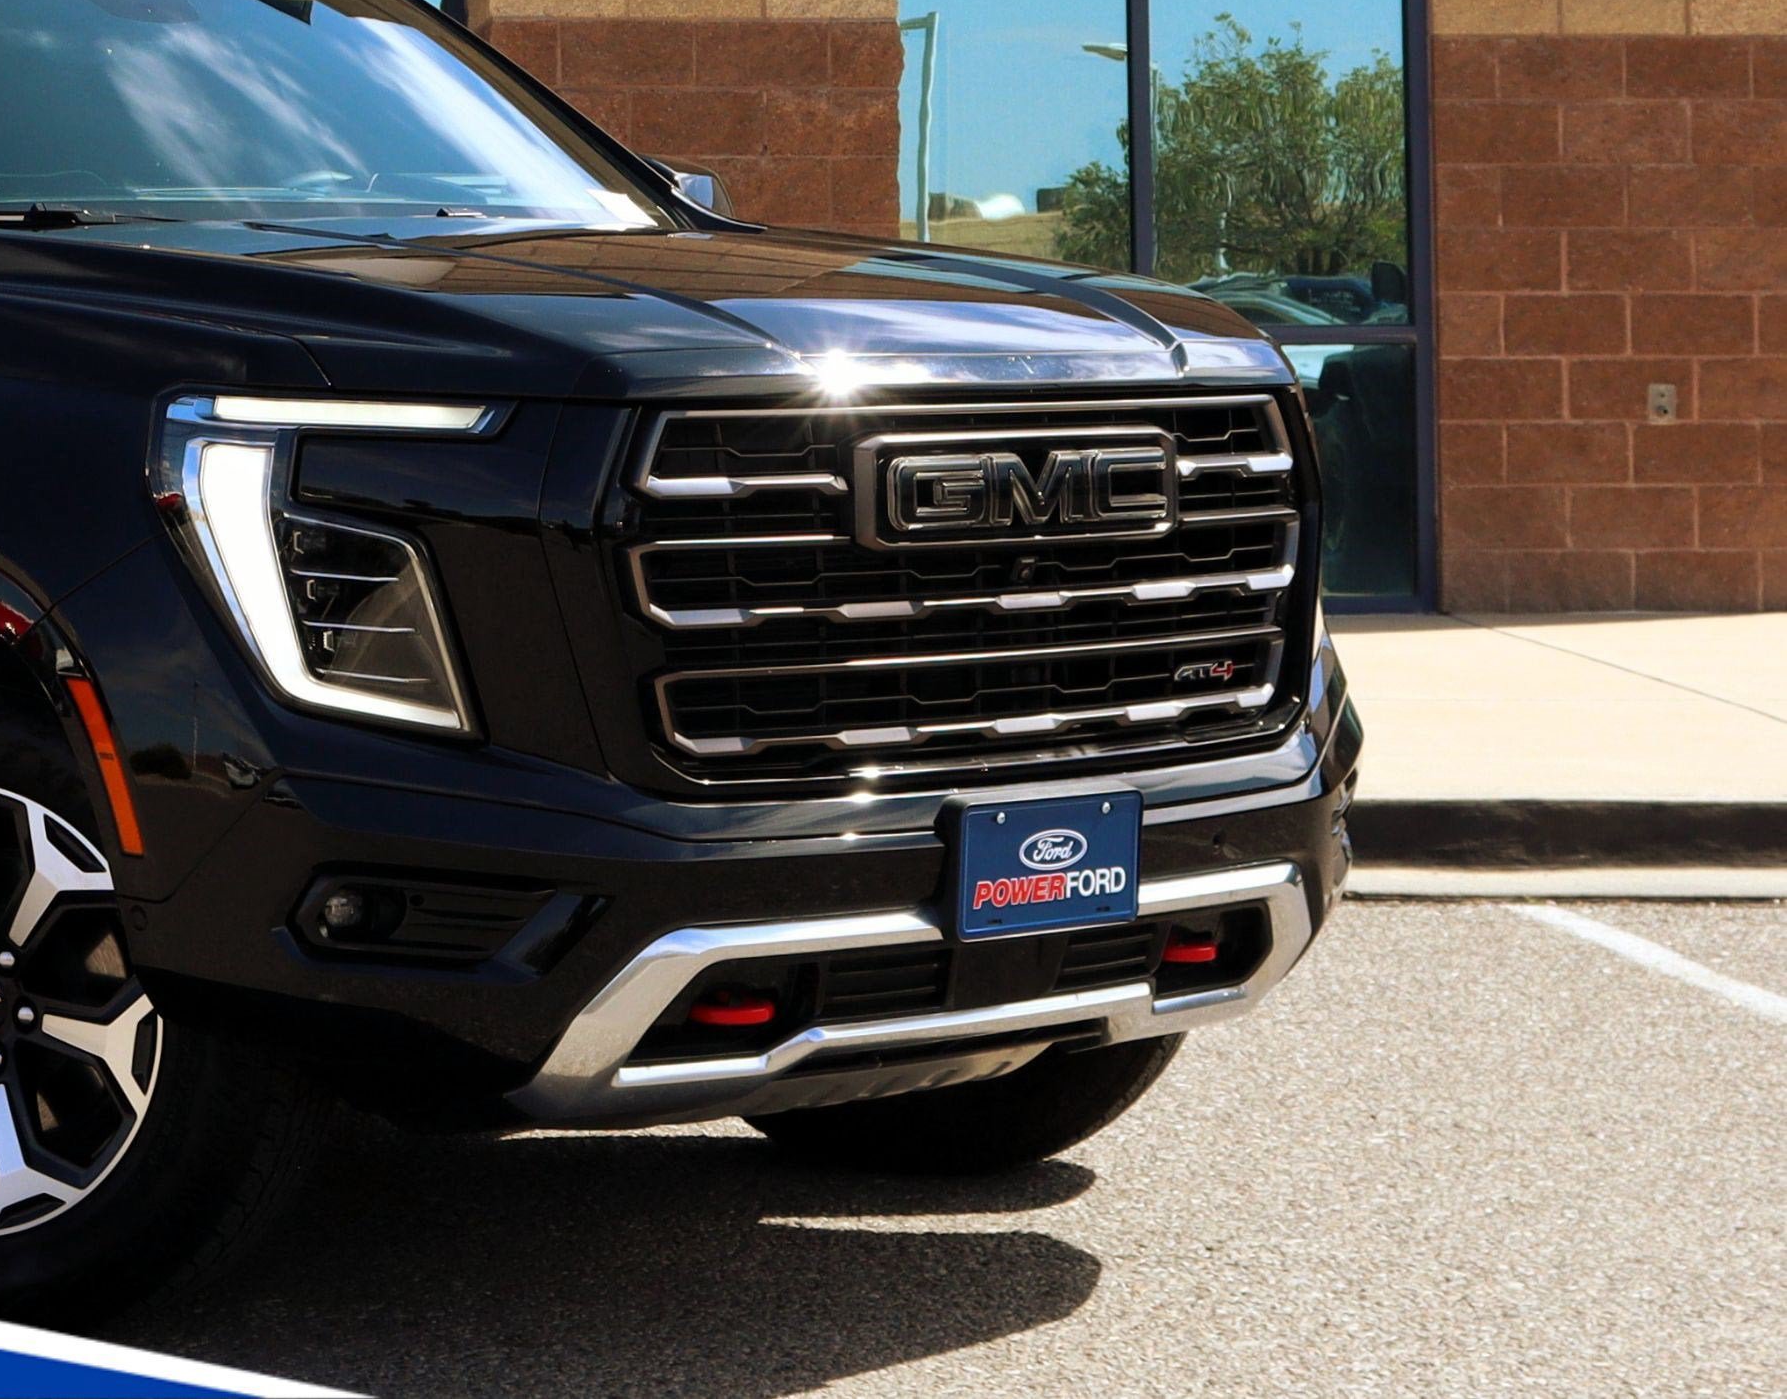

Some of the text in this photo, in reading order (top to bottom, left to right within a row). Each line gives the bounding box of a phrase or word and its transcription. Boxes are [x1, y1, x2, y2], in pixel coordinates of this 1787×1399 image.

[887, 446, 1168, 532] GMC
[1174, 661, 1233, 681] AT4
[1032, 836, 1074, 862] Ford
[972, 866, 1126, 910] POWERFORD
